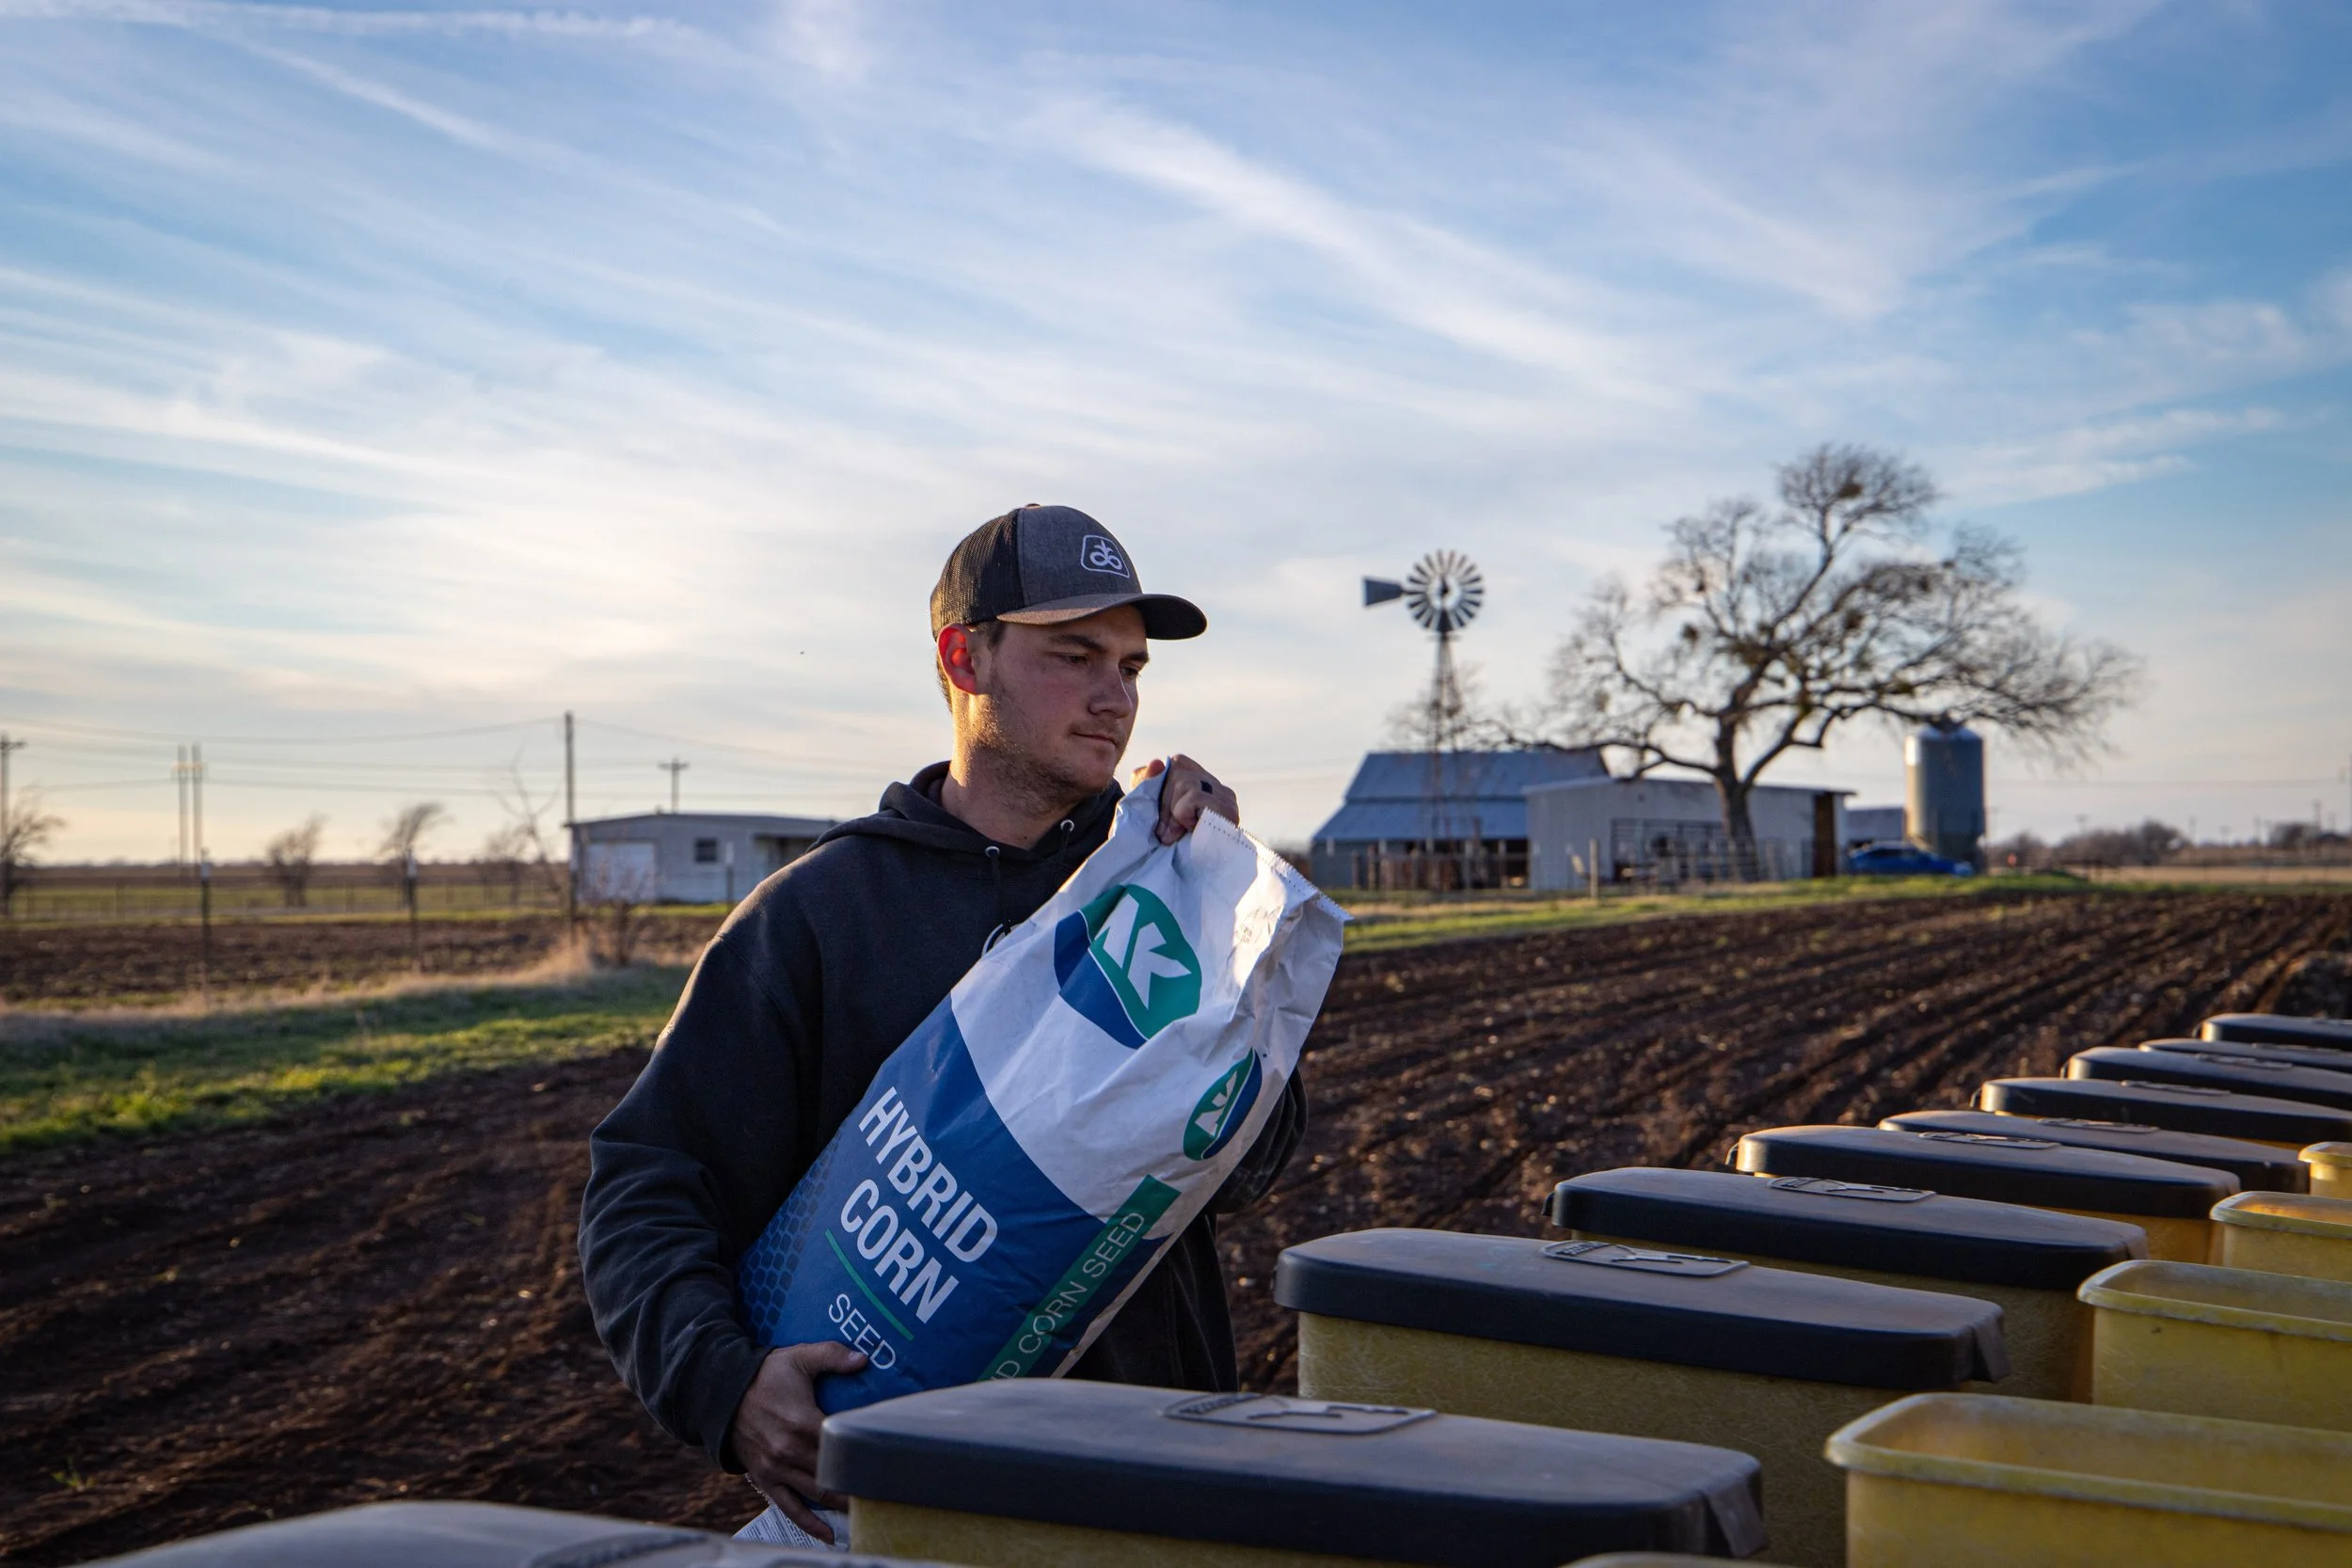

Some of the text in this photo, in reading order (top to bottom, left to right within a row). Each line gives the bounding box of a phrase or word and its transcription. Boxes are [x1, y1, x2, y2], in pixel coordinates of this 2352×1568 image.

[858, 1086, 998, 1263] HYBRID
[840, 1179, 960, 1324] CORN
[1019, 1280, 1088, 1354] CORN
[1083, 1212, 1145, 1278] SEED
[828, 1293, 897, 1370] SEED
